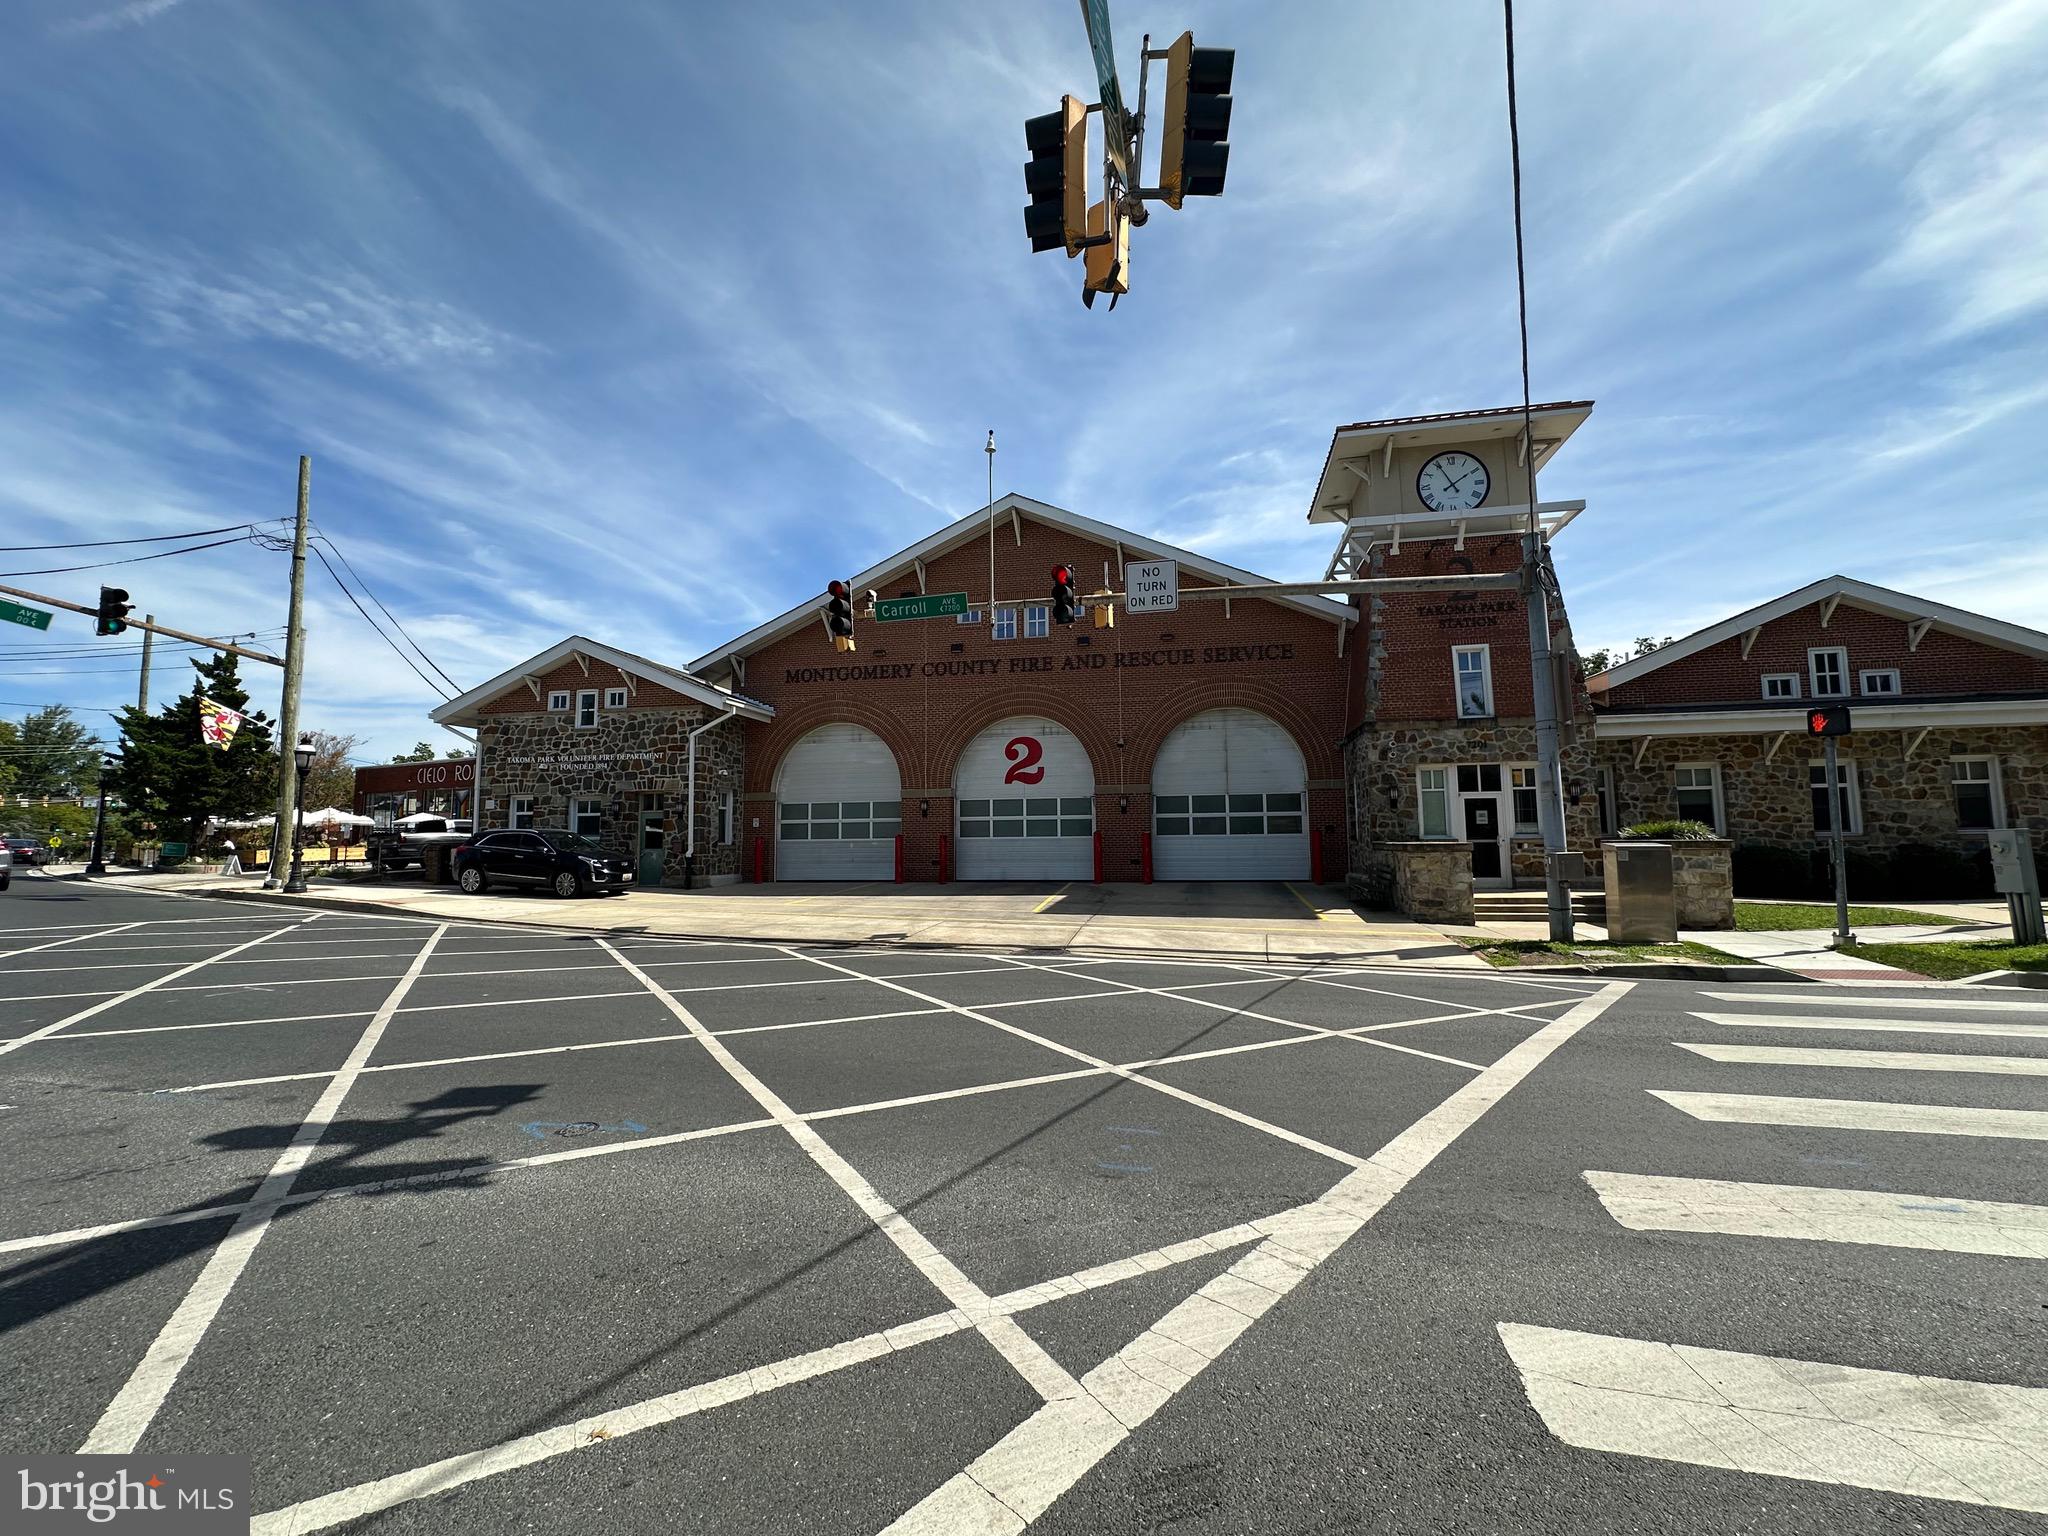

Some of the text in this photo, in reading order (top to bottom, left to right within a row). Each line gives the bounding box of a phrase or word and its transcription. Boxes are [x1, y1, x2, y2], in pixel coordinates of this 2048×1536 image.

[1142, 567, 1160, 578] NO
[1136, 581, 1167, 592] TURN
[942, 597, 956, 605] AVE
[1130, 594, 1173, 607] ON RED
[18, 609, 39, 619] AVE
[881, 601, 927, 617] Carroll
[1416, 600, 1518, 616] TAKOMA PARK
[1439, 616, 1498, 629] STATION
[784, 643, 1296, 684] MONTGOMERY COUNTY FIRE AND RESCUE SERVICE
[507, 756, 536, 764] TAKOMA
[537, 755, 556, 763] PARK
[557, 754, 597, 762] VOLUNTEER
[616, 752, 664, 760] DEPARTMENT
[1004, 736, 1045, 785] 2
[560, 763, 594, 771] FOUNDED
[417, 766, 447, 784] CIELO
